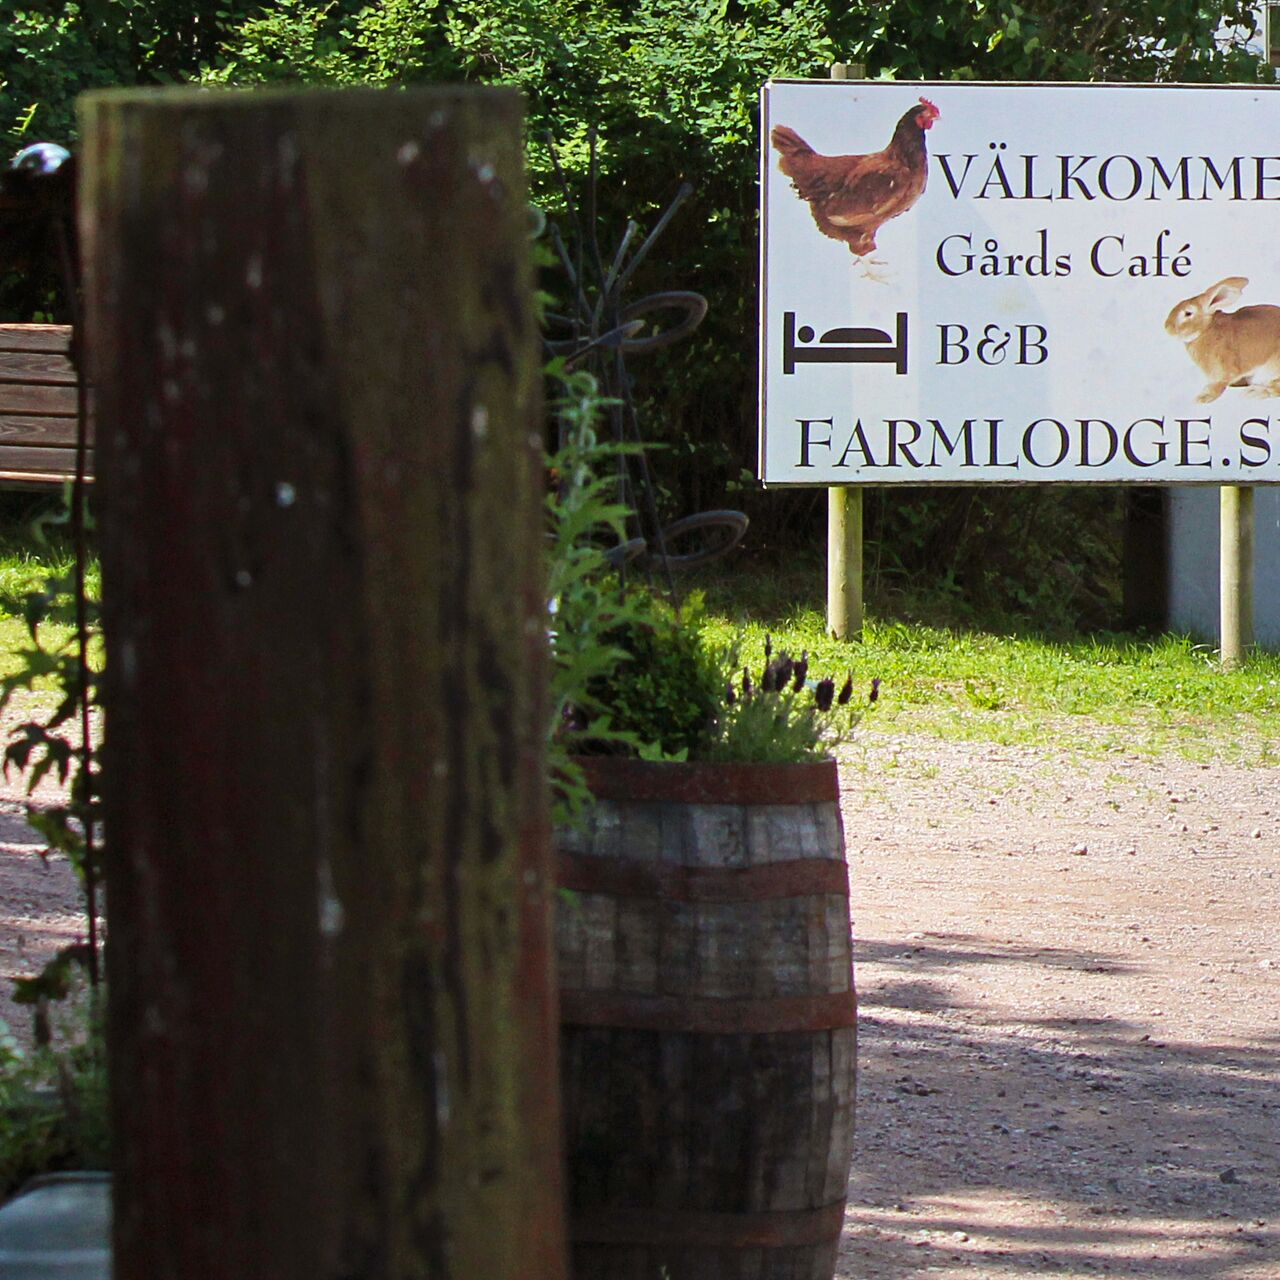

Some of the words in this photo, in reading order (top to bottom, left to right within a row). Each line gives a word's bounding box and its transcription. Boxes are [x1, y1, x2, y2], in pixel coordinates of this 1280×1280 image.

[935, 229, 1071, 278] Gårds
[1089, 229, 1192, 278] Café
[935, 324, 1049, 367] B&B
